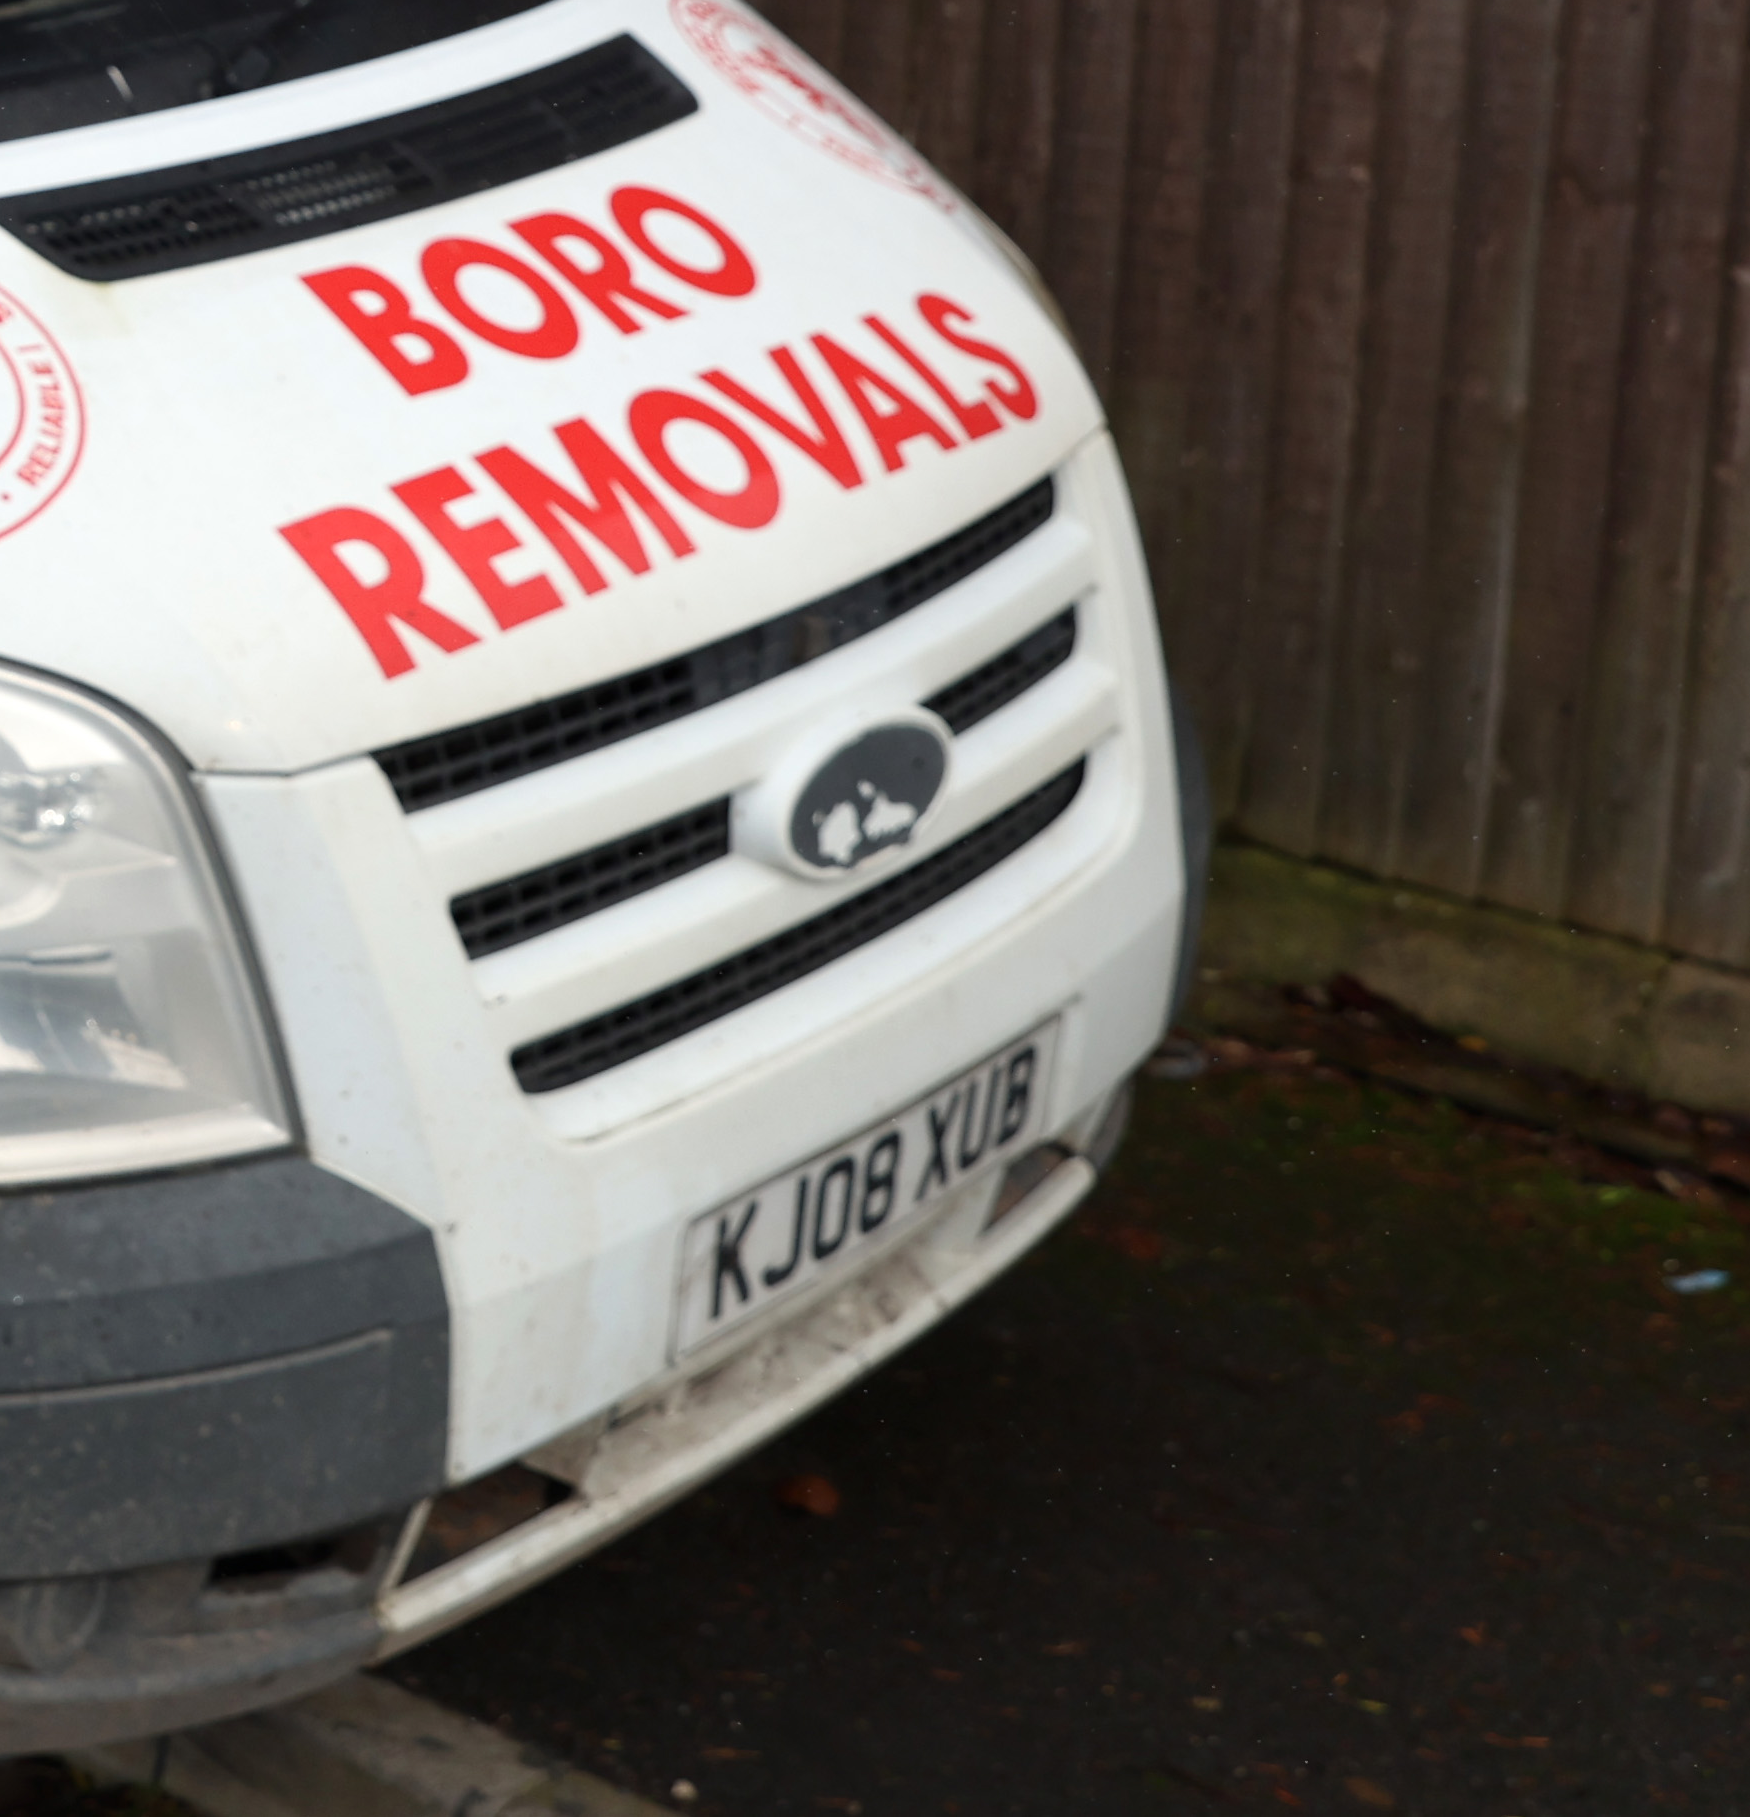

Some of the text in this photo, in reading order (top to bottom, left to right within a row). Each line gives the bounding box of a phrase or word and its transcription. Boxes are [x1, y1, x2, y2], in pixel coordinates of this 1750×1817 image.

[297, 184, 757, 398] BORO
[276, 292, 1041, 681] REMOVALS
[709, 1042, 1040, 1319] KJ08 XUB
